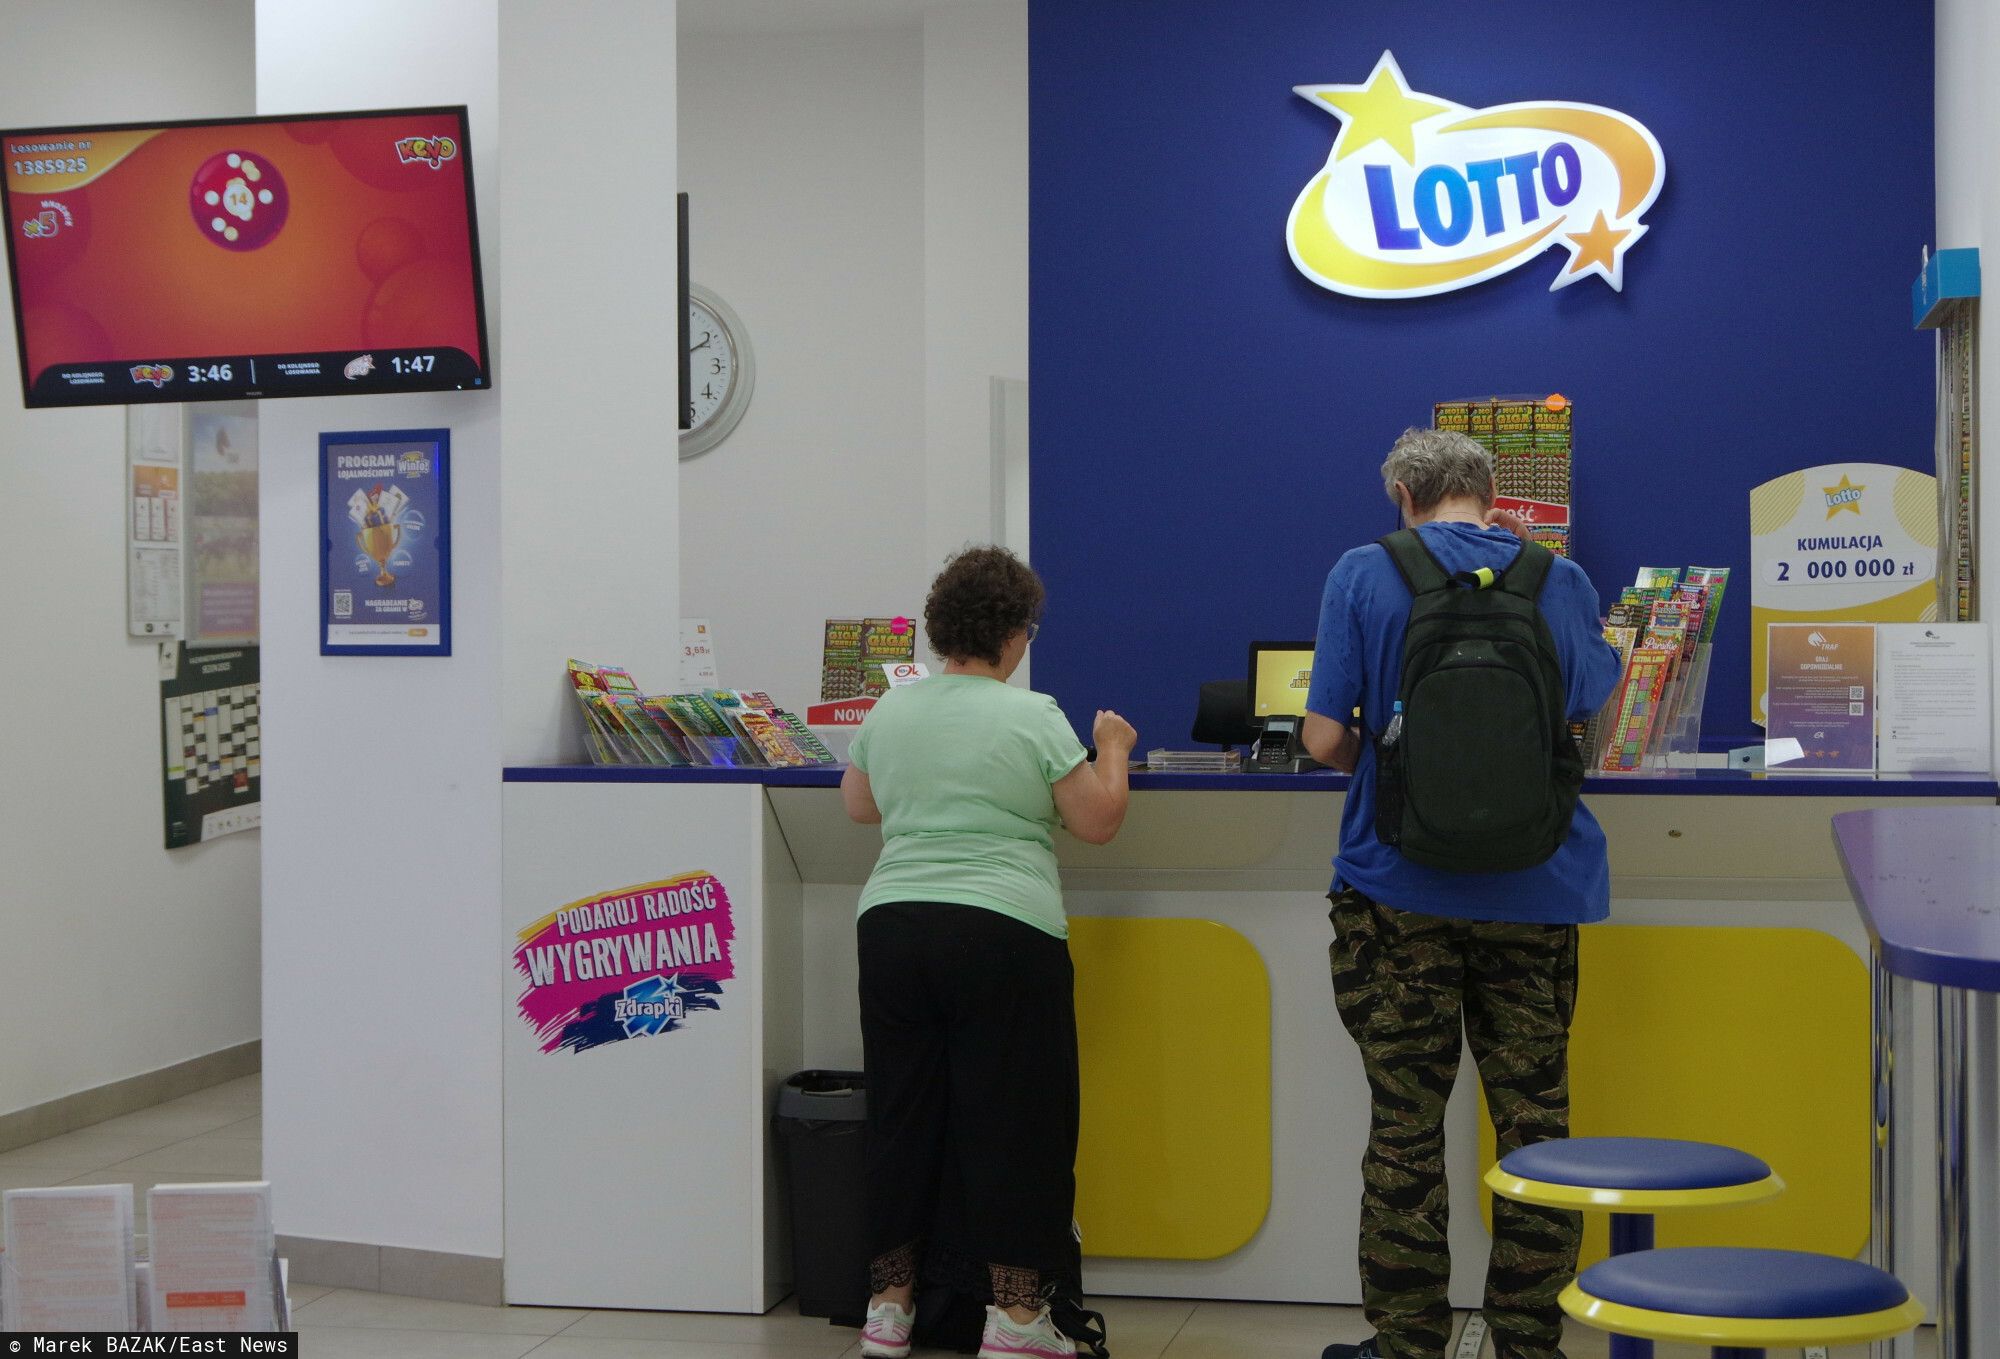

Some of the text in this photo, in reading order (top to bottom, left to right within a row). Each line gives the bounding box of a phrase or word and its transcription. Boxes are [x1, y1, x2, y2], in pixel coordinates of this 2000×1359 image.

[11, 140, 92, 153] Losowanie nr
[14, 157, 87, 176] 1385925
[230, 193, 248, 206] 14
[1363, 141, 1583, 251] LOTTO
[187, 364, 234, 383] 3:46
[391, 355, 435, 374] 1:47
[337, 454, 395, 468] PROGRAM
[337, 468, 395, 479] LOJALNOŚCIOWY
[1825, 487, 1862, 508] Lotto
[1797, 535, 1883, 552] KUMULACJA
[1777, 558, 1914, 581] 2 000 000 zł
[866, 635, 911, 647] GIGA
[834, 708, 869, 721] NOW
[555, 877, 717, 937] PODARUJ RADOŚĆ
[525, 922, 721, 988] WYGRYWANIA
[616, 996, 682, 1020] Zdrapki
